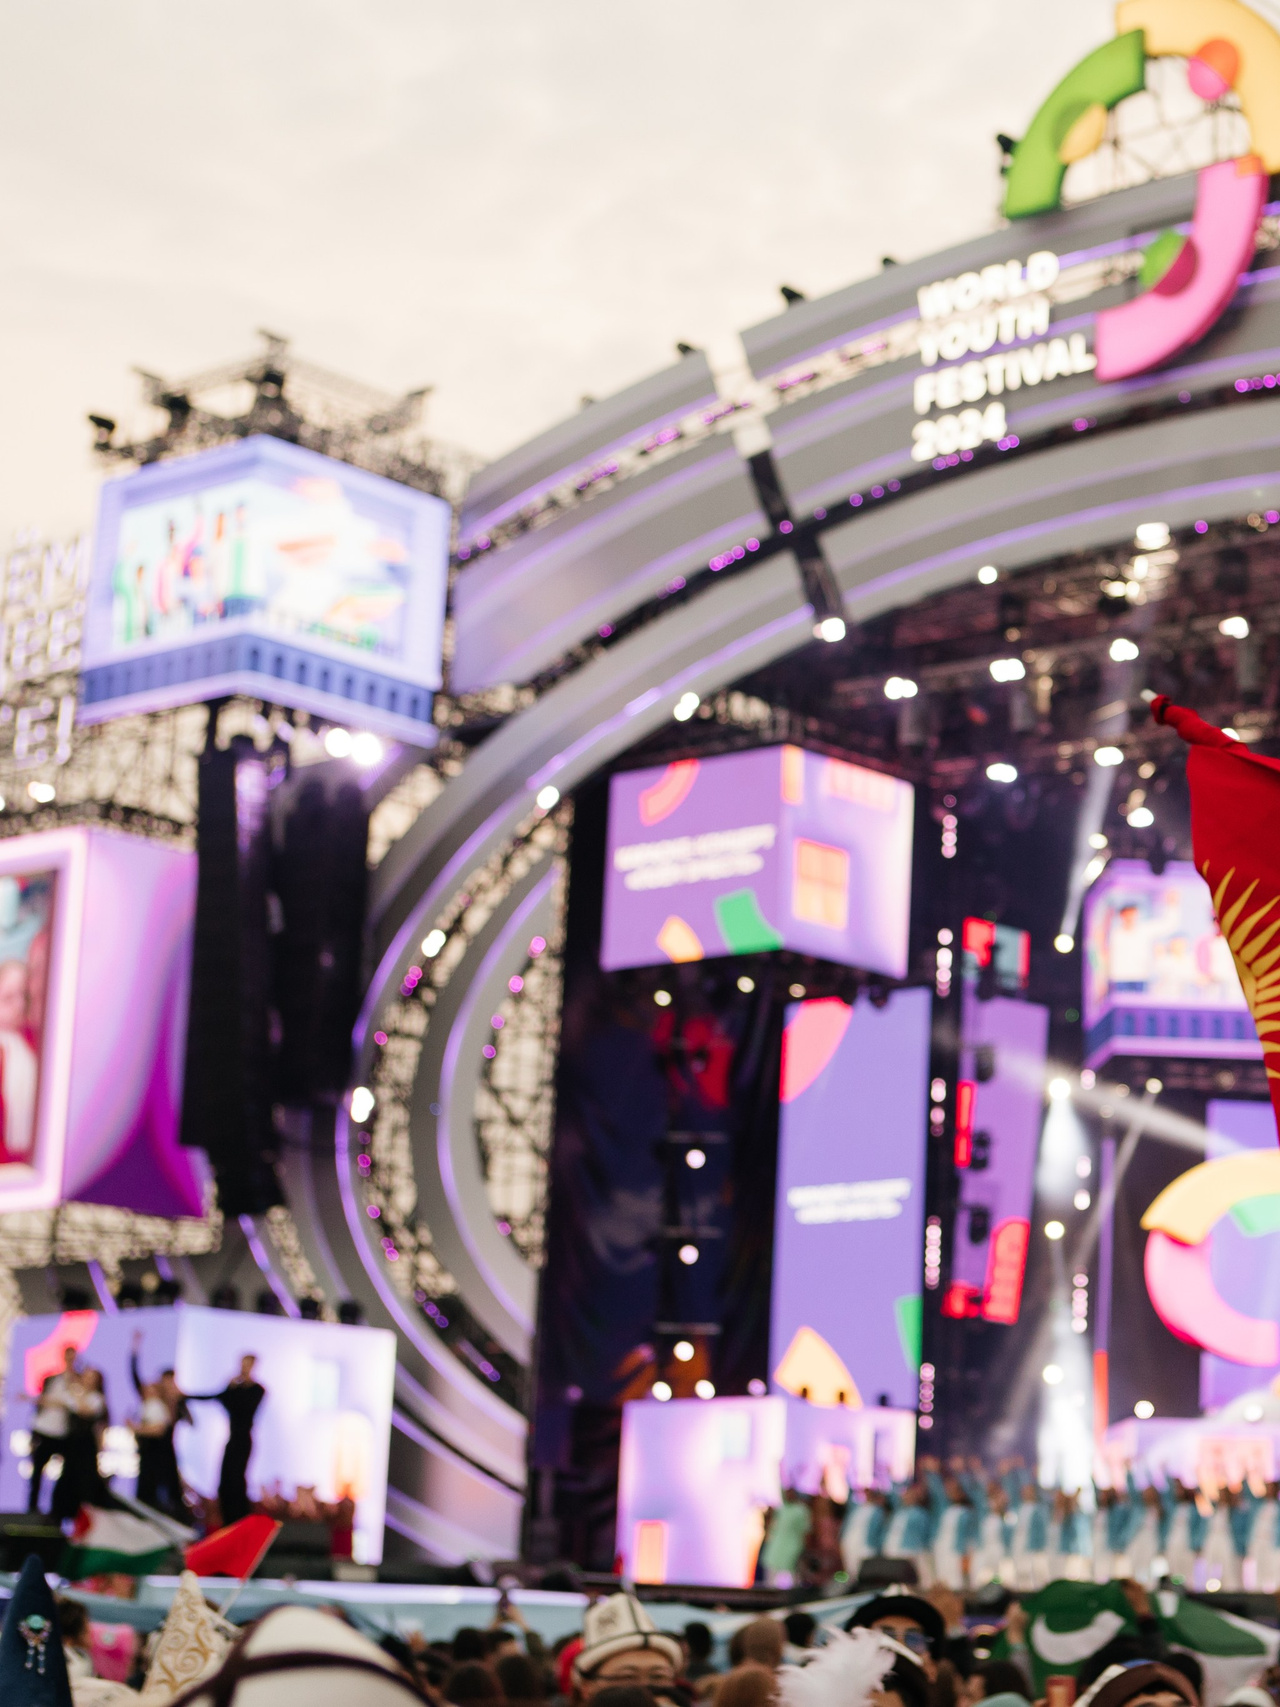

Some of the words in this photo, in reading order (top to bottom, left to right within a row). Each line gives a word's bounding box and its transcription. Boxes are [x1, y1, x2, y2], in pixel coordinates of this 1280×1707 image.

[917, 251, 1060, 320] WORLD
[917, 297, 1050, 367] YOUTH
[913, 333, 1098, 415] FESTIVAL
[911, 401, 1008, 462] 2024
